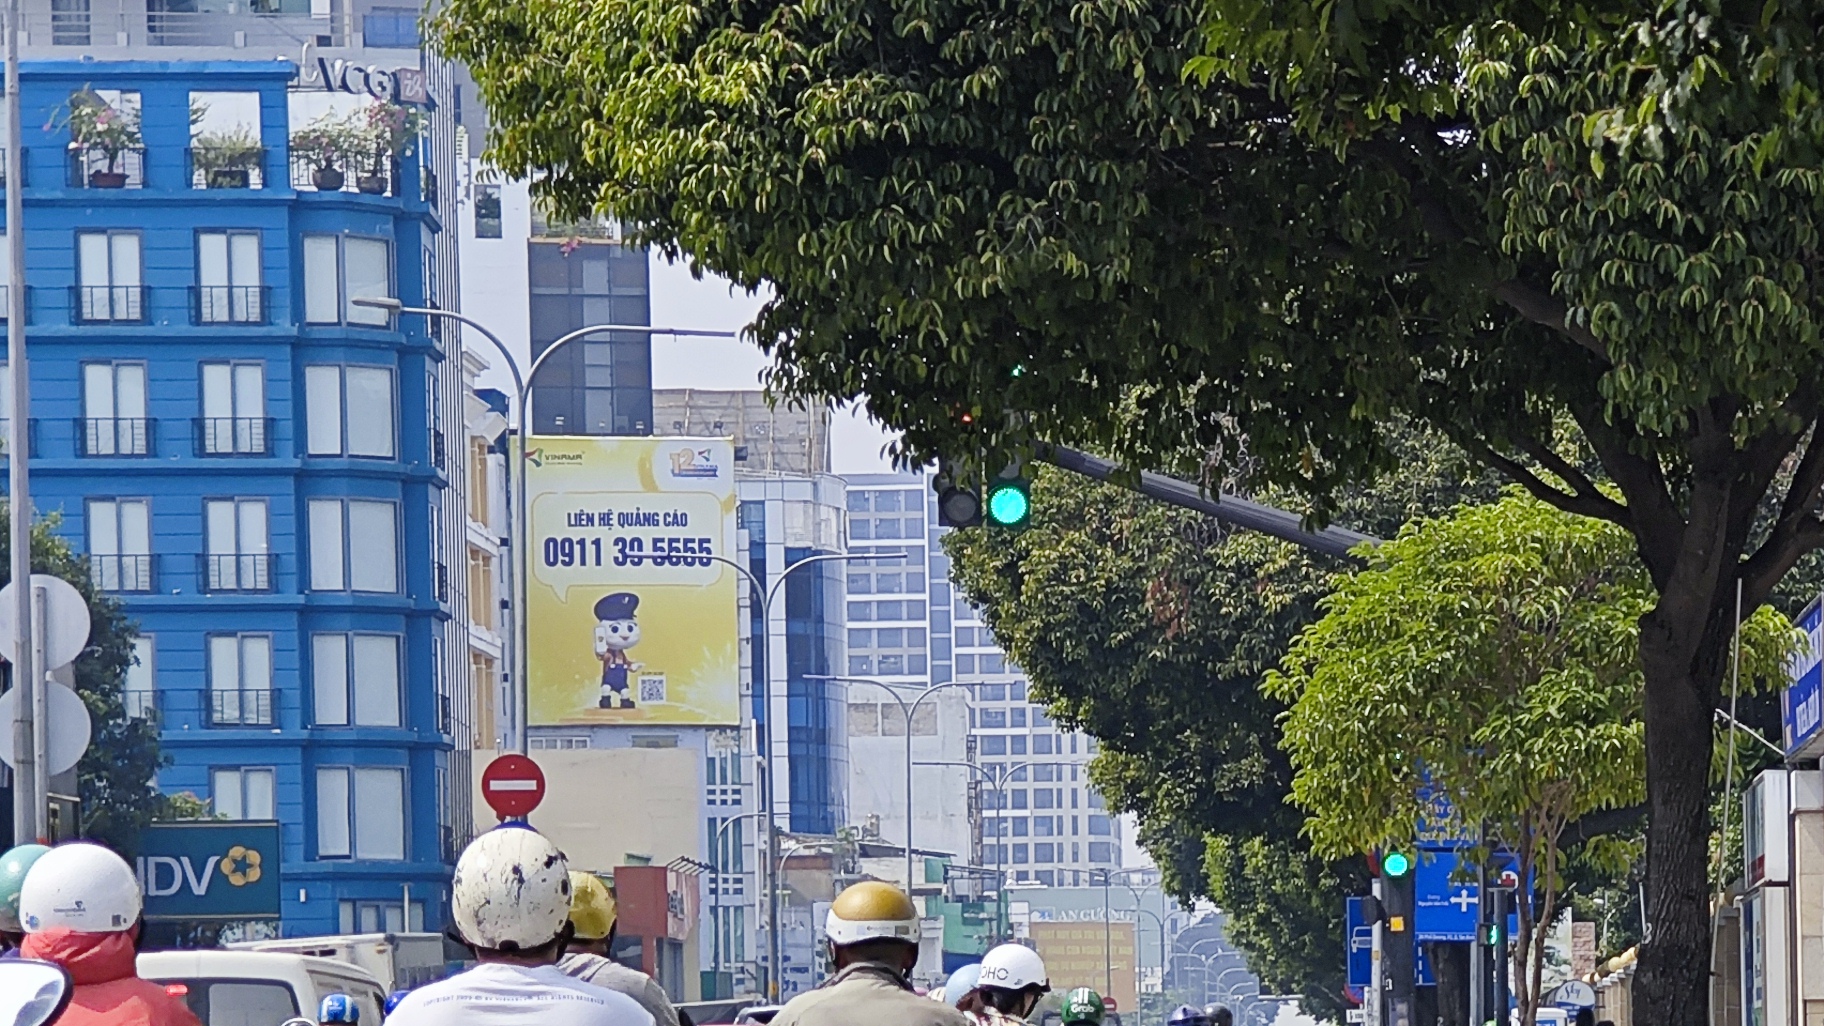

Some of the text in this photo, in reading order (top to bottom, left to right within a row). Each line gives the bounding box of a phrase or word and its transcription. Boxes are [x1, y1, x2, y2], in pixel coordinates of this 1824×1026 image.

[567, 507, 689, 531] LIÊN HỆ QUẢNG CÁO
[544, 537, 602, 567] 0911
[652, 538, 713, 567] 5555
[1058, 909, 1079, 921] AN
[1071, 1004, 1096, 1013] Grab
